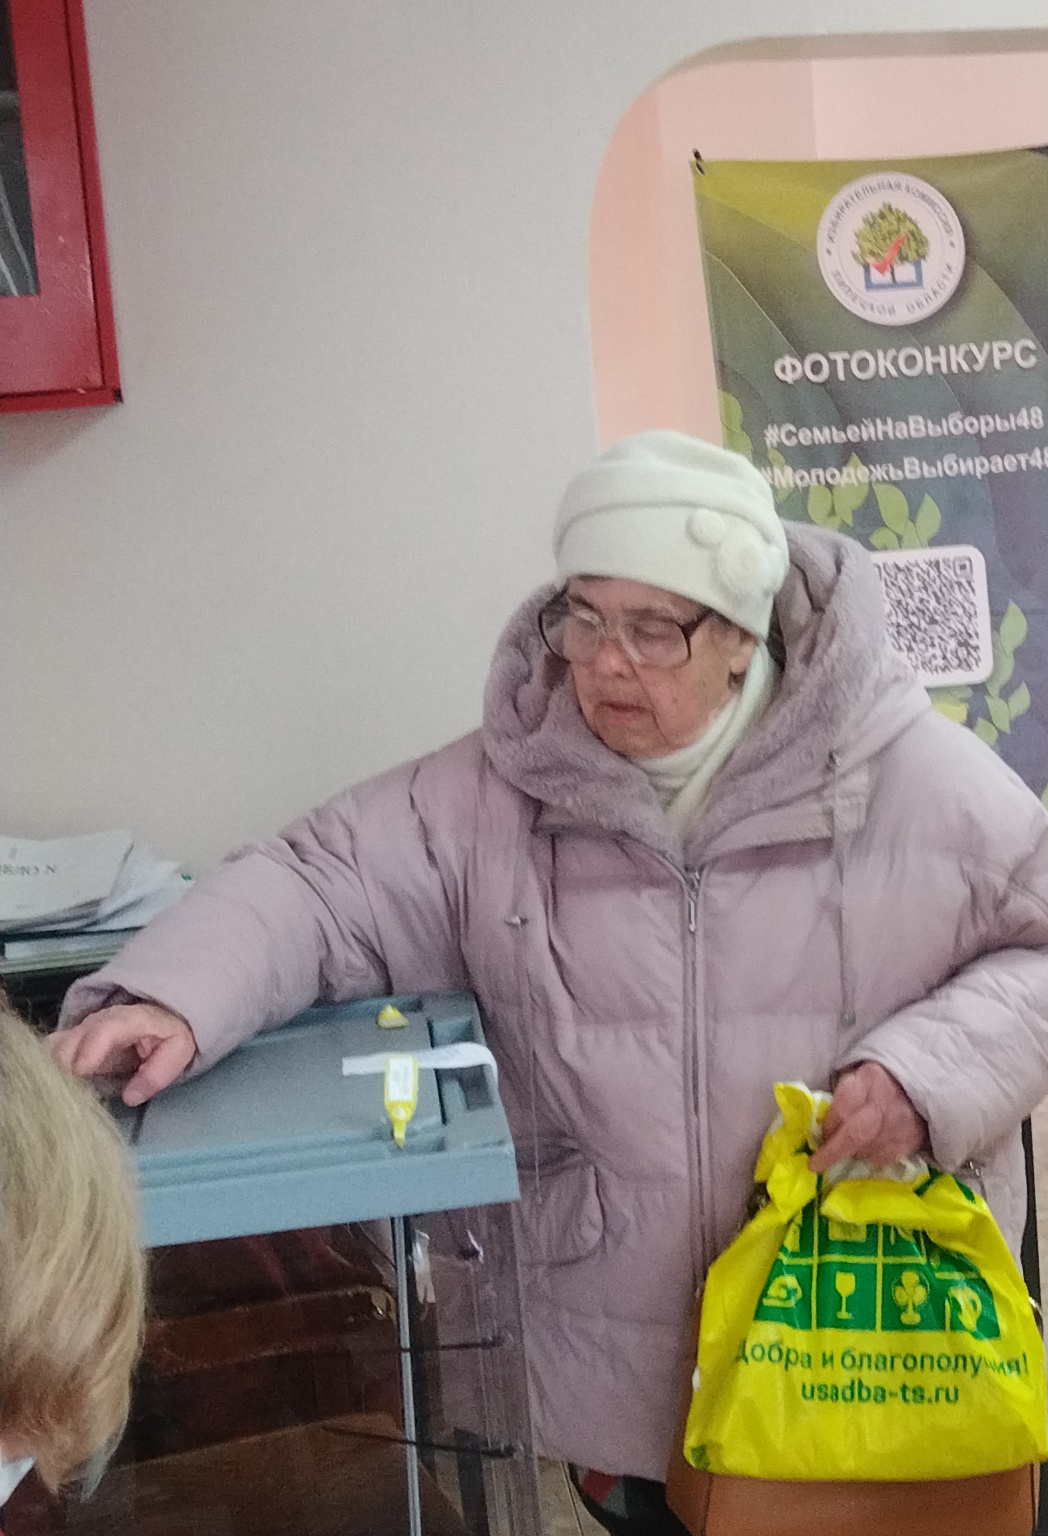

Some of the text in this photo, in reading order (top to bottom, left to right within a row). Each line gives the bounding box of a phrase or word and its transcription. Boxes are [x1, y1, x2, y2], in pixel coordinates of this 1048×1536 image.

[773, 338, 1038, 385] ФОТОКОНКУРС
[763, 406, 1045, 449] #СемьейНаВыборы48
[821, 1350, 834, 1368] и
[801, 1378, 960, 1405] usadba-ts.ru
